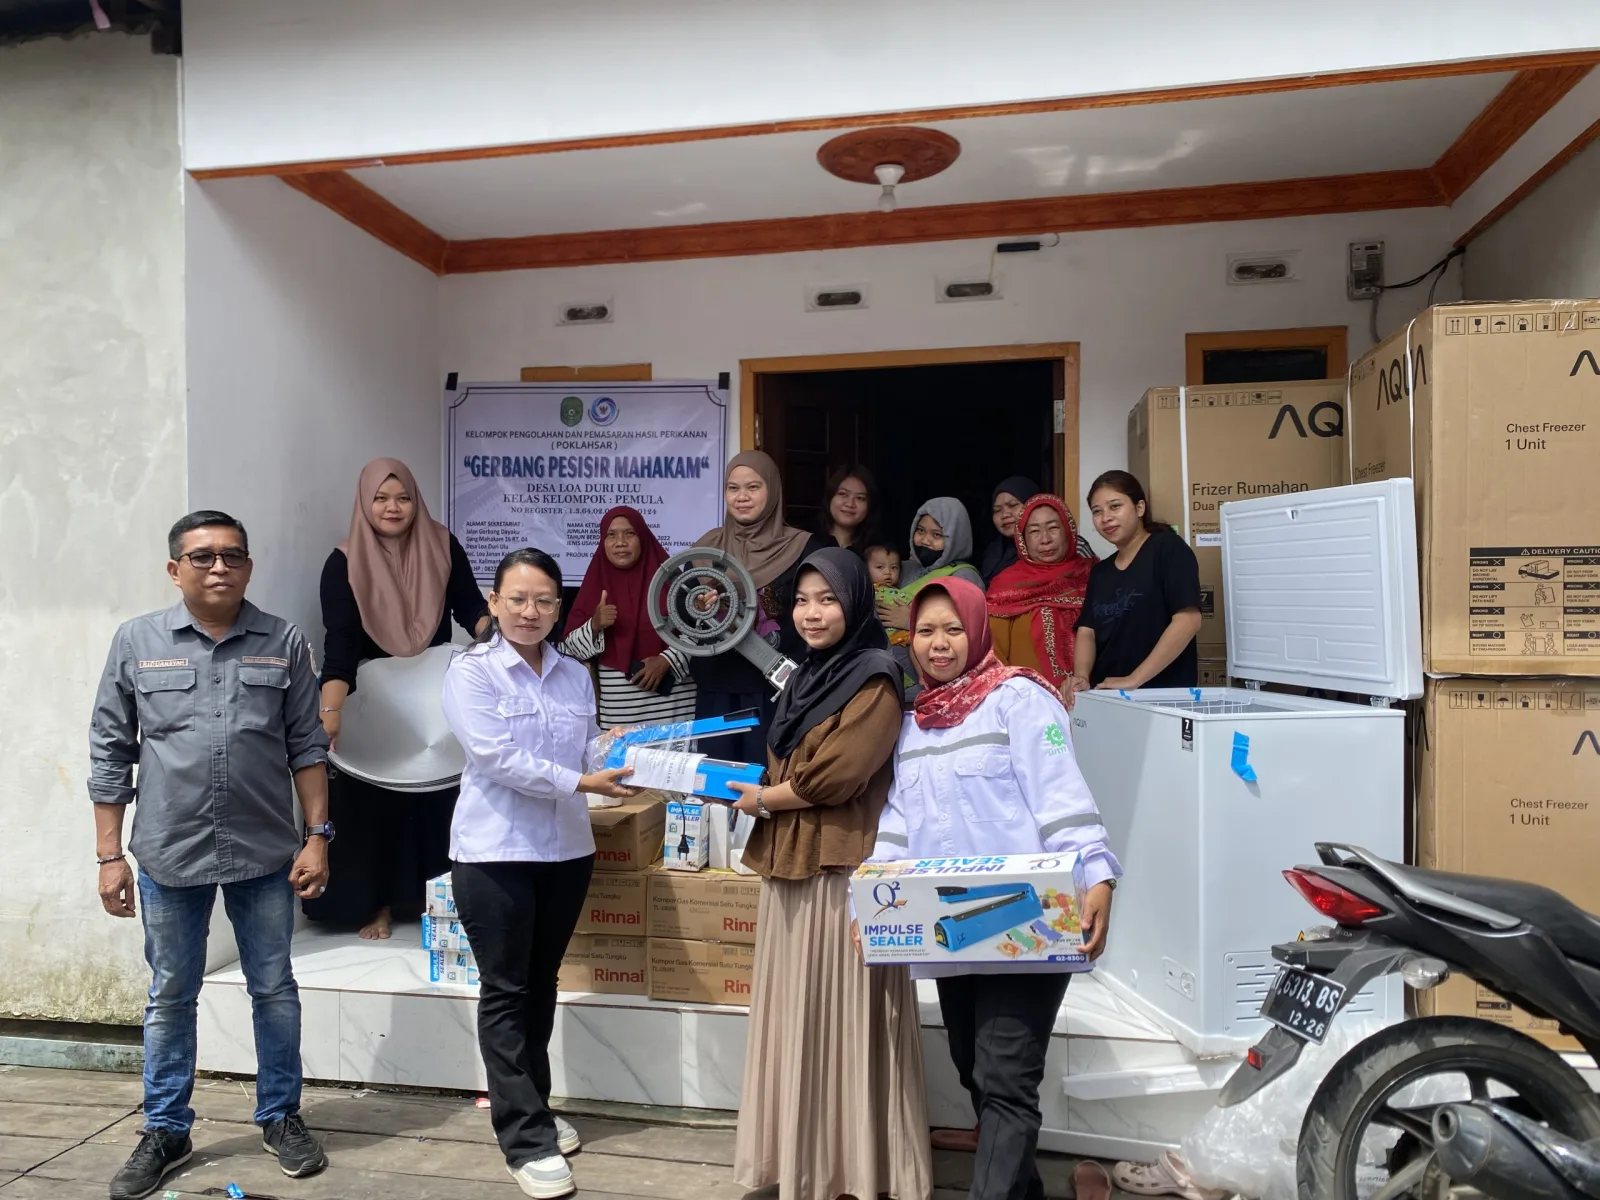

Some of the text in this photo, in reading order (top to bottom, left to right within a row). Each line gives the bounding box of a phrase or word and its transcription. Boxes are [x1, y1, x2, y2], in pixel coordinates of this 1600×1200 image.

[1376, 344, 1427, 411] AQUA
[1506, 422, 1587, 433] Chest Freezer
[465, 430, 708, 439] KELOMPOK PENGOLAHAN DAN PEMASARAN HASIL PERIKANAN
[556, 441, 613, 450] POKLAHSAR
[1505, 438, 1547, 450] 1 Unit
[548, 455, 611, 479] PESISIR
[526, 483, 642, 493] DESA LOA DURI ULU
[1192, 480, 1309, 496] Frizer Rumahan
[503, 493, 541, 504] KELAS
[542, 494, 607, 504] KELOMPOK
[615, 494, 665, 505] PEMULA
[510, 506, 523, 514] NO
[524, 507, 563, 515] REGISTER
[1192, 501, 1215, 512] Dua
[1510, 798, 1589, 810] Chest Freezer
[1509, 813, 1551, 826] 1 Unit
[590, 909, 641, 925] Rinnai
[864, 924, 924, 935] IMPULSE
[869, 935, 923, 947] SEALER
[594, 968, 645, 983] Rinnai
[1283, 974, 1315, 1003] 6313
